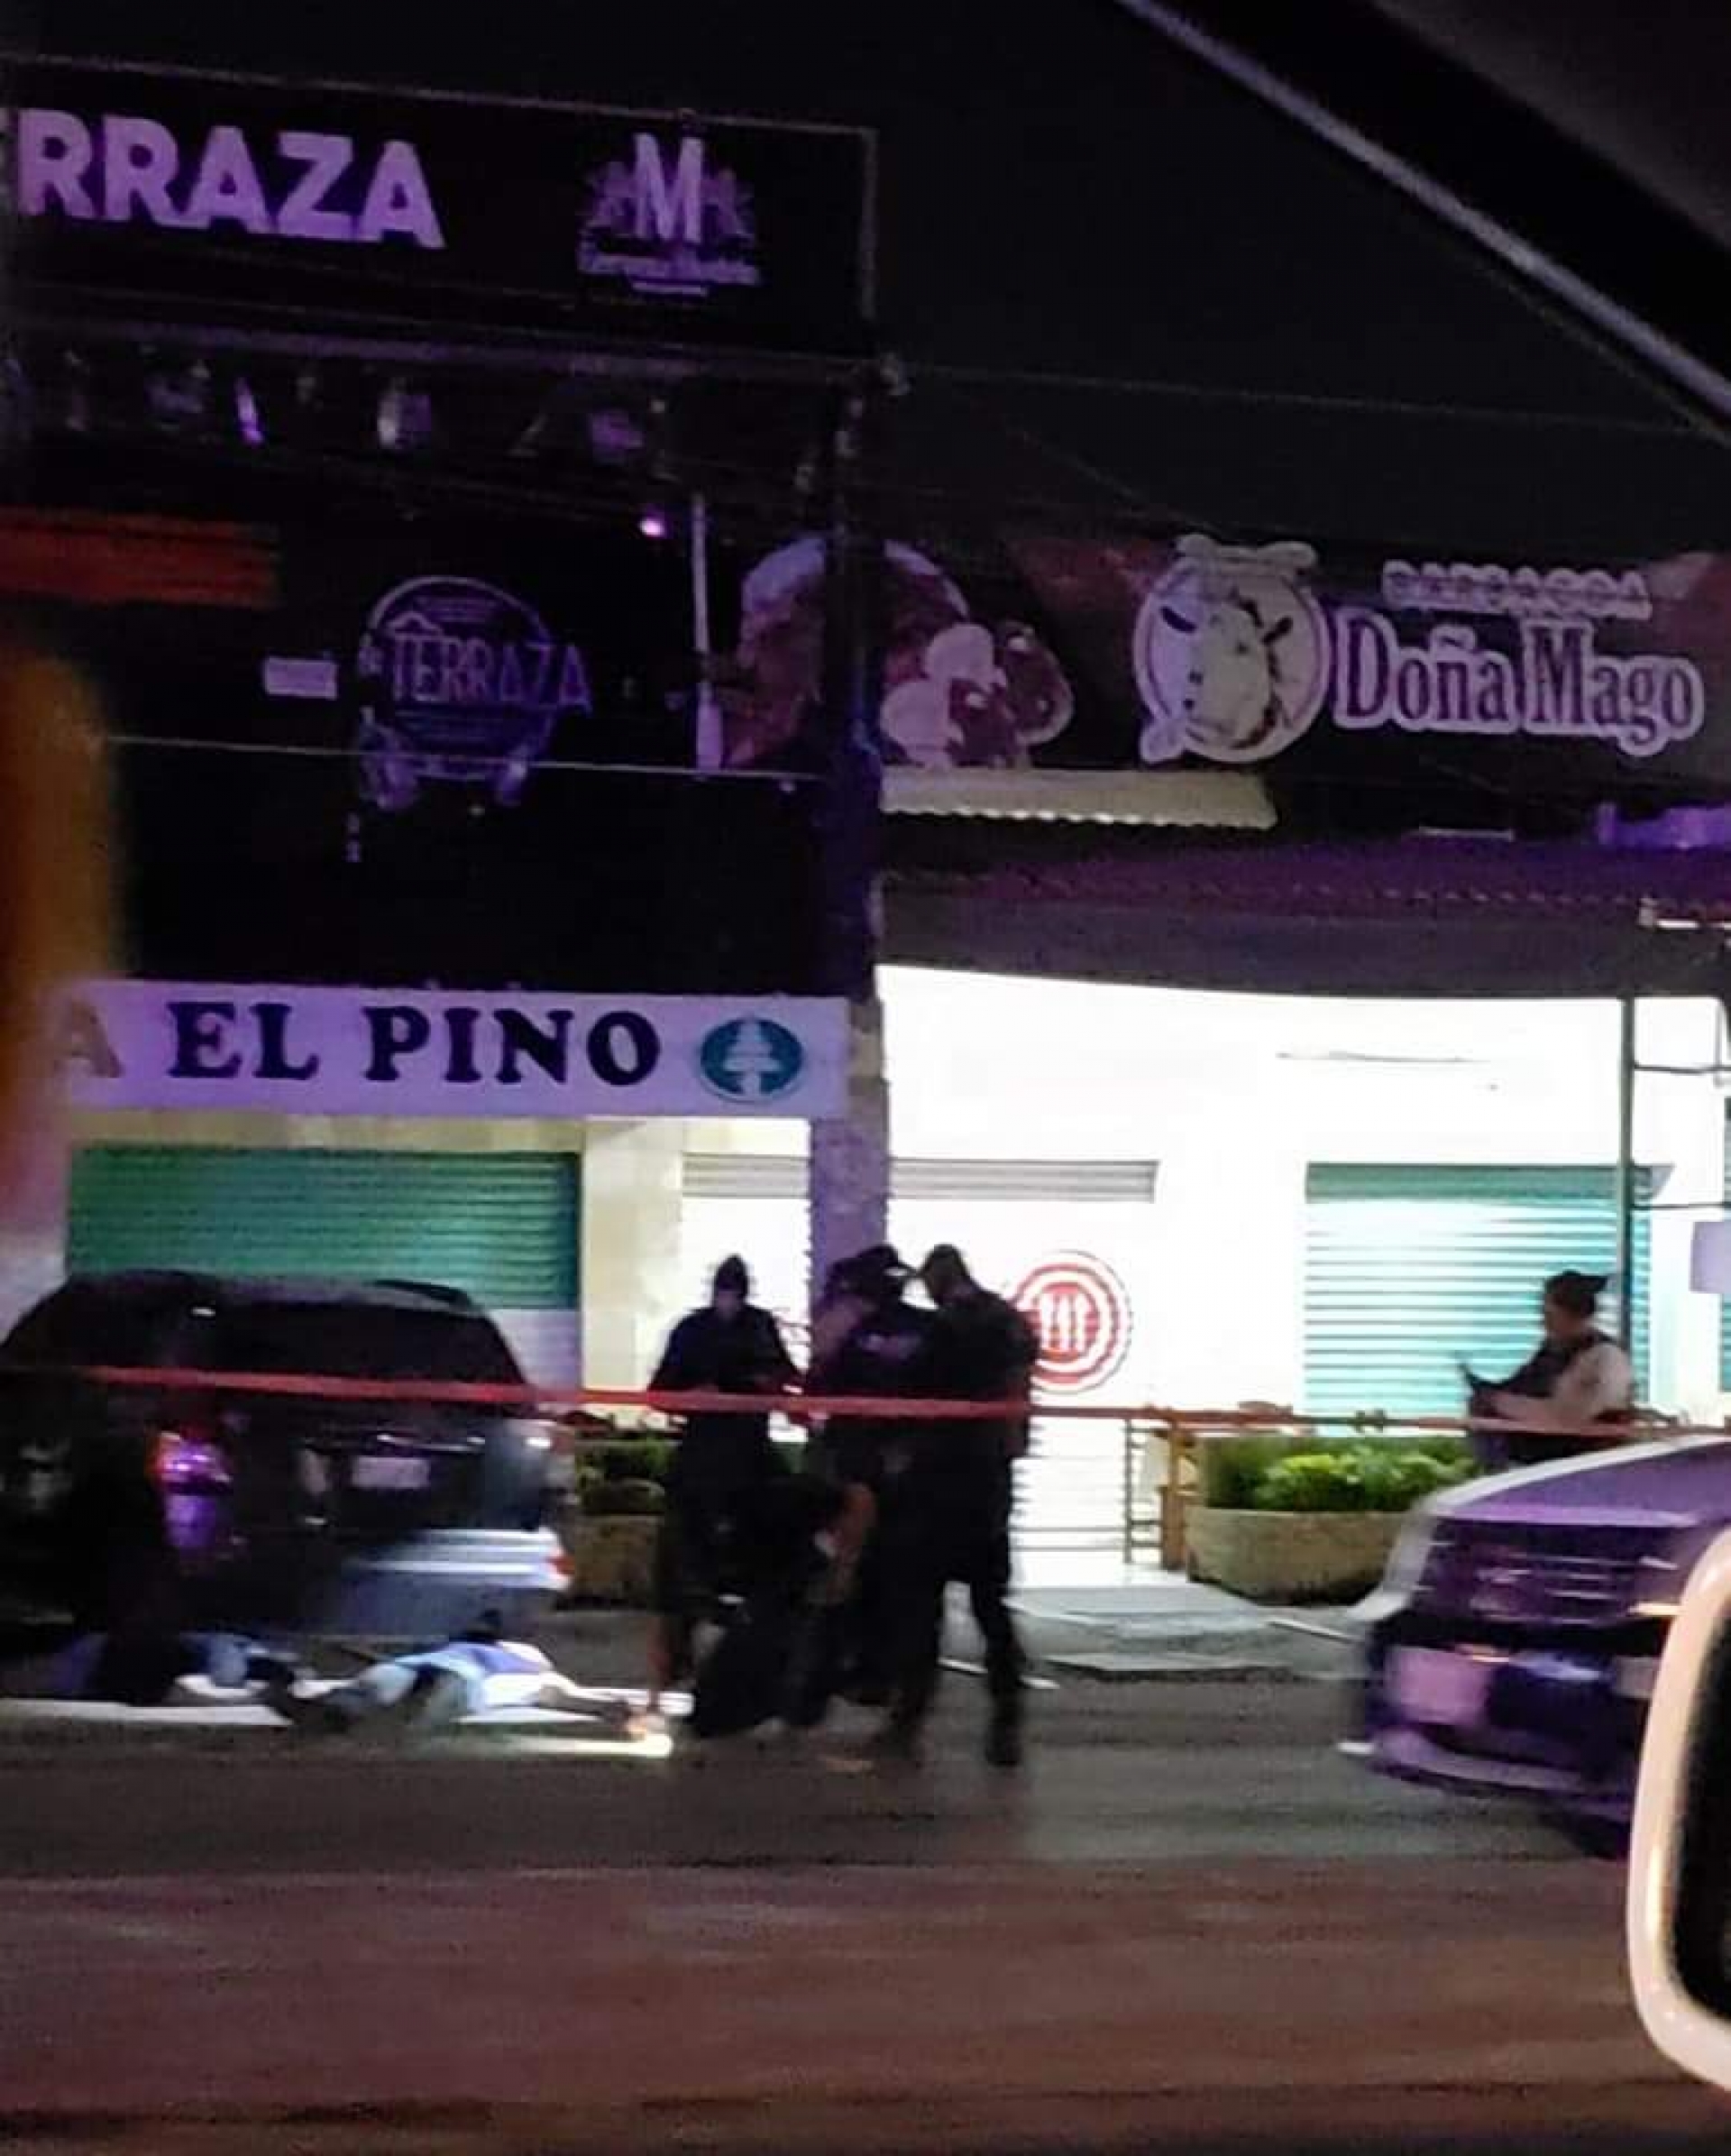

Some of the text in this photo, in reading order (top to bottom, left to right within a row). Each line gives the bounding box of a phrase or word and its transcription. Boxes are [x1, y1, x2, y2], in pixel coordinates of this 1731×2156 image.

[0, 108, 446, 249] RRAZA
[388, 634, 593, 711] TERRAZA
[1342, 615, 1695, 747] Doña Mago
[168, 1001, 319, 1080] EL
[362, 1005, 661, 1086] PINO
